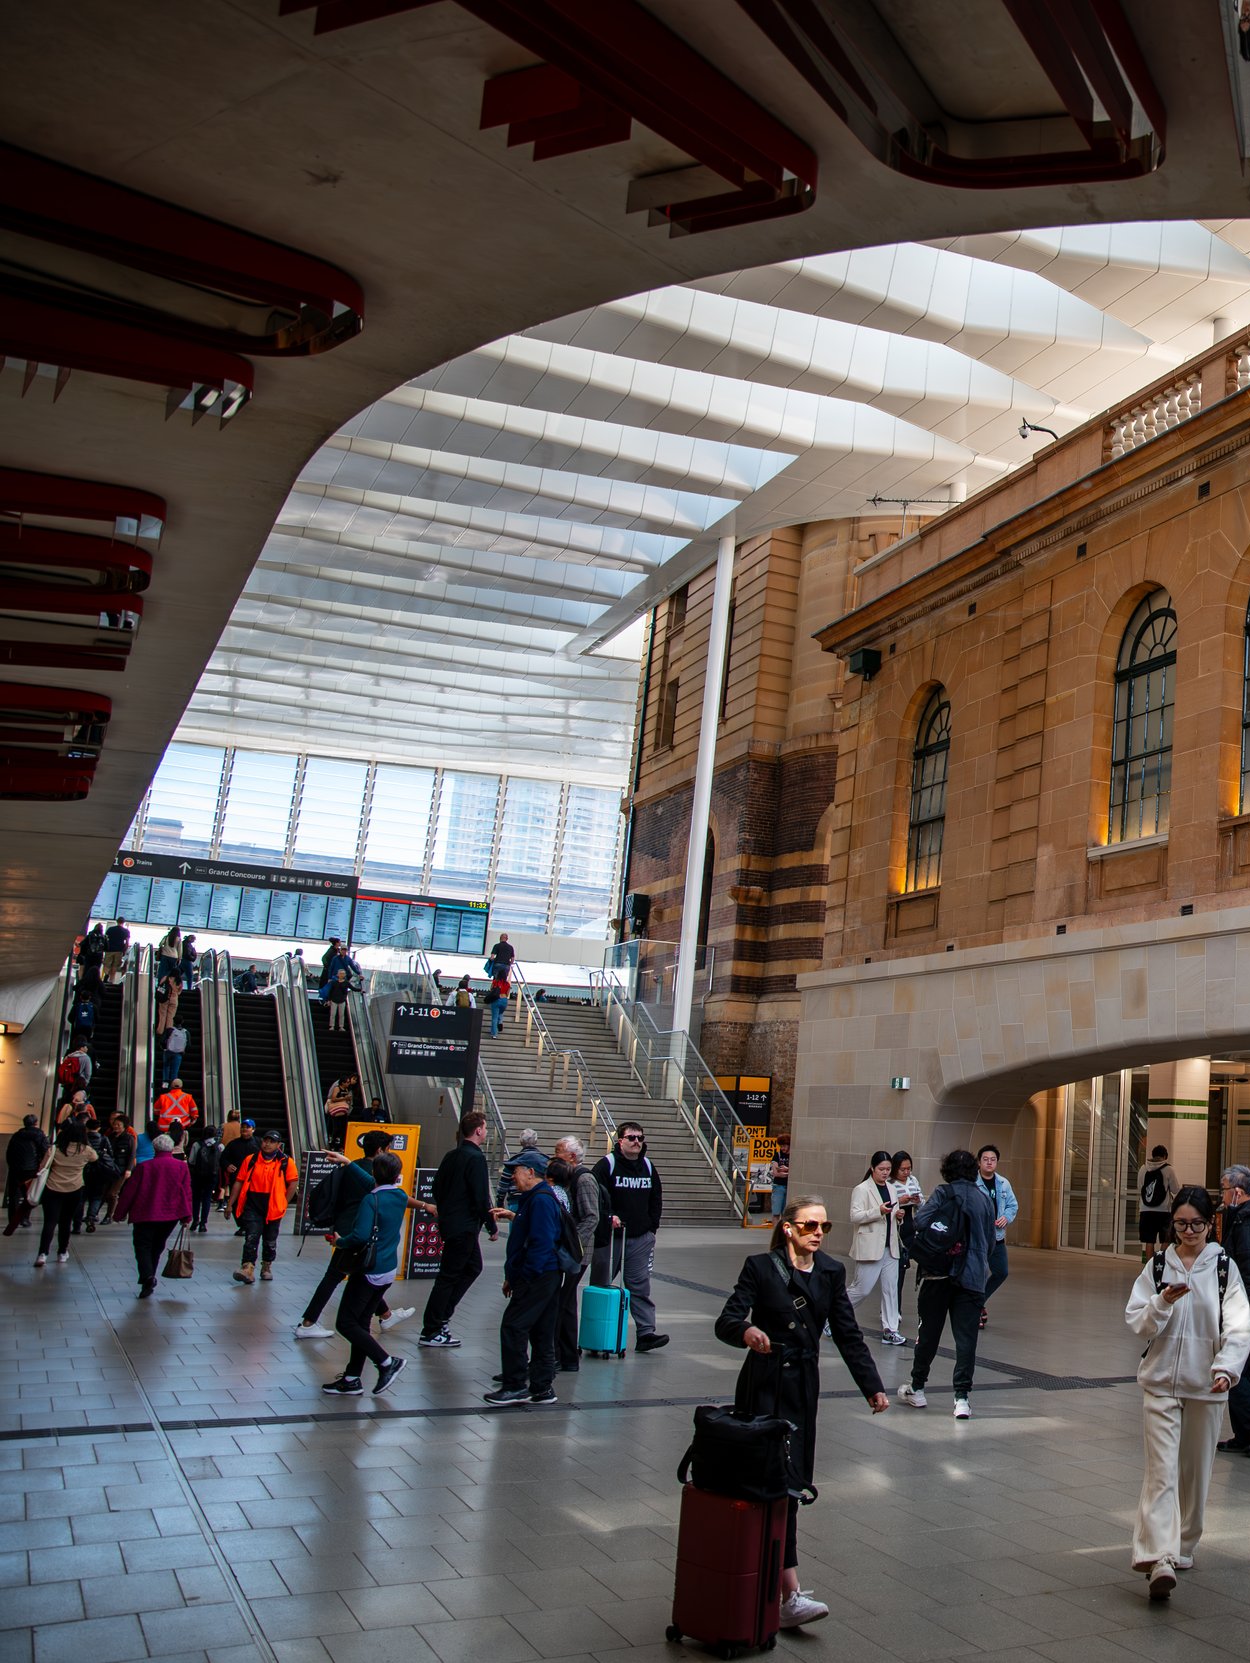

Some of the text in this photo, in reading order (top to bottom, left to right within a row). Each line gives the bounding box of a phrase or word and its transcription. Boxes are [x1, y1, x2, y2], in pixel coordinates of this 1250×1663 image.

[136, 859, 153, 867] Trains
[208, 868, 229, 877] Grand
[230, 870, 266, 880] Concourse
[469, 901, 487, 909] 11:32
[409, 1007, 429, 1017] 1-11
[737, 1127, 765, 1136] DON'T
[754, 1139, 777, 1149] DON
[753, 1148, 776, 1158] RUS
